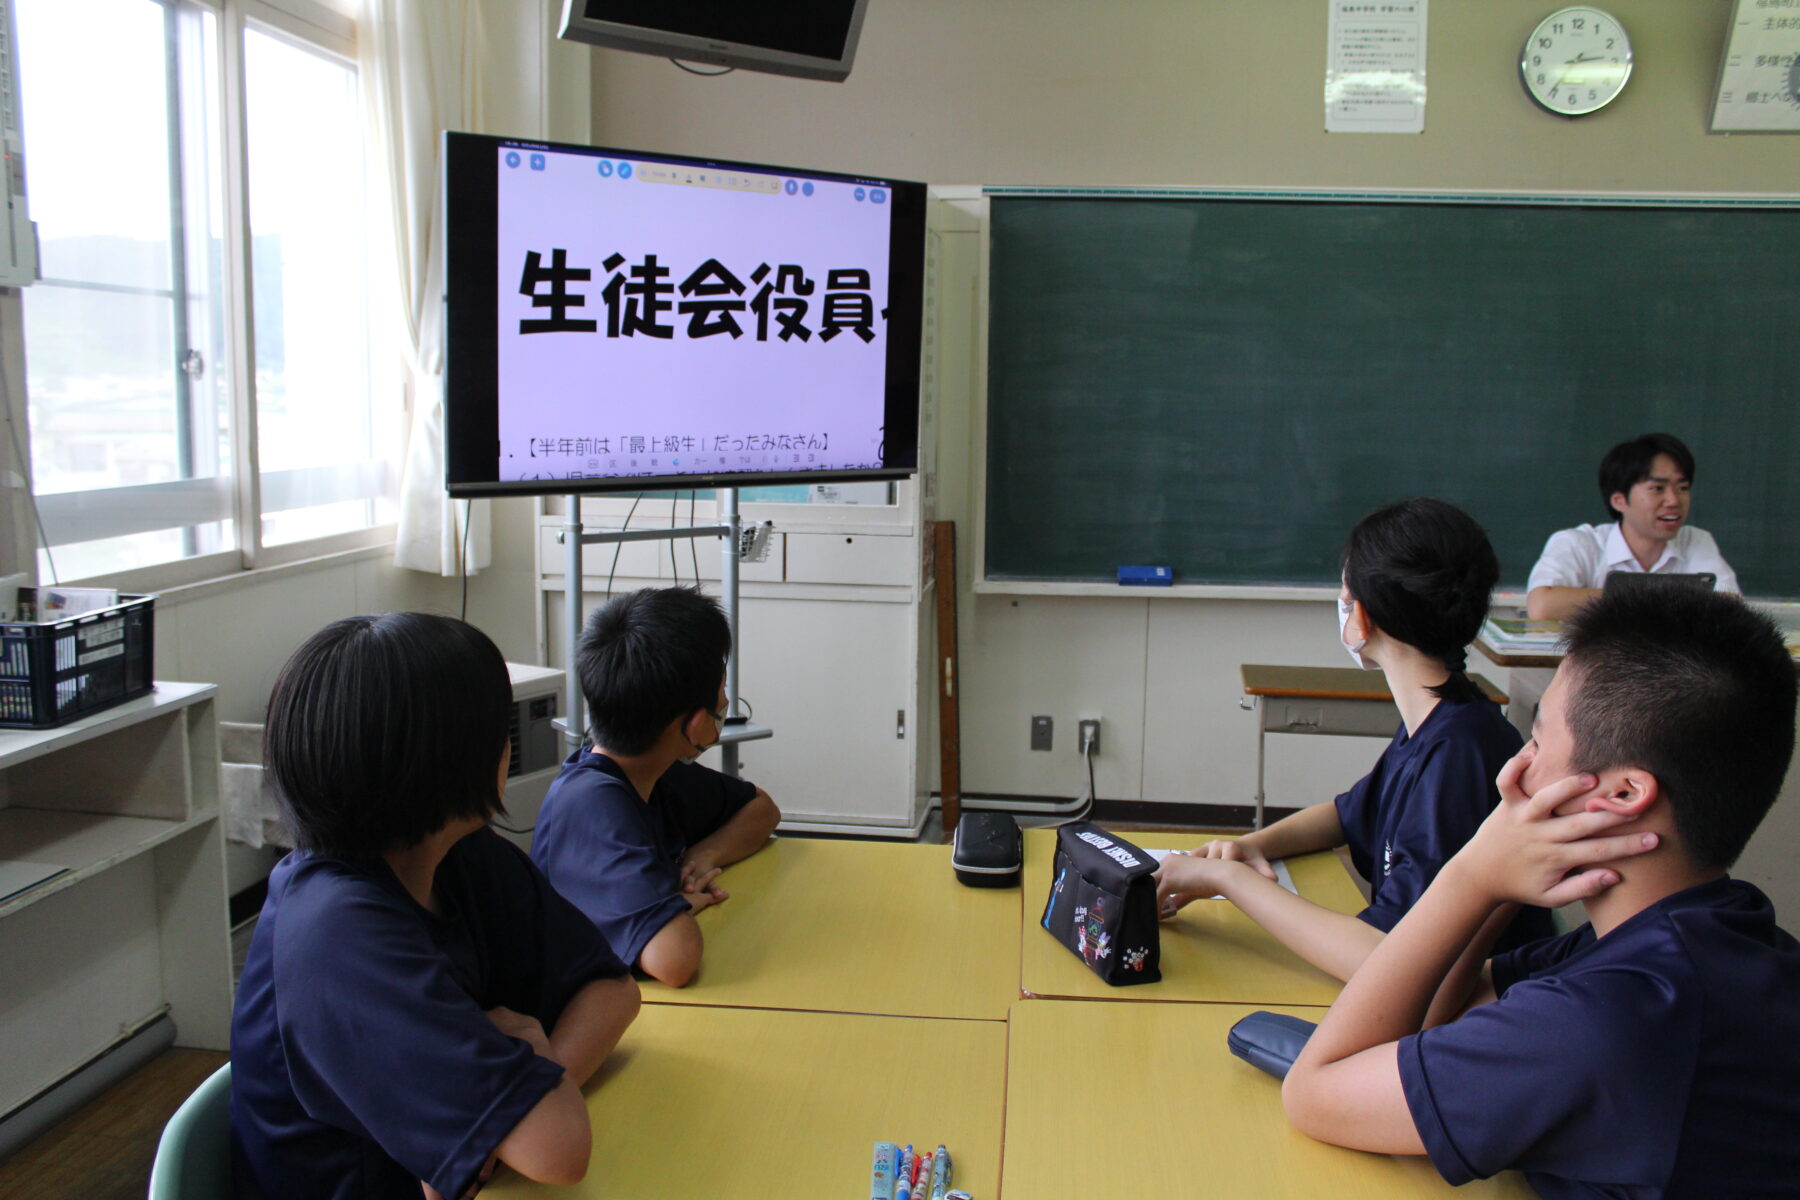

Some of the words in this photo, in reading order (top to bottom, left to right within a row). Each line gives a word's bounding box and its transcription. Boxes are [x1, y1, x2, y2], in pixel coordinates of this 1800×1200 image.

[1552, 23, 1564, 34] 11
[1572, 18, 1585, 30] 12
[1594, 23, 1600, 35] 1
[1539, 38, 1552, 49] 10
[1605, 38, 1614, 49] 2
[1532, 55, 1541, 66] 9
[1537, 74, 1545, 85] 8
[1568, 94, 1577, 105] 6
[1588, 89, 1597, 100] 5
[519, 247, 889, 344] 生徒会役員
